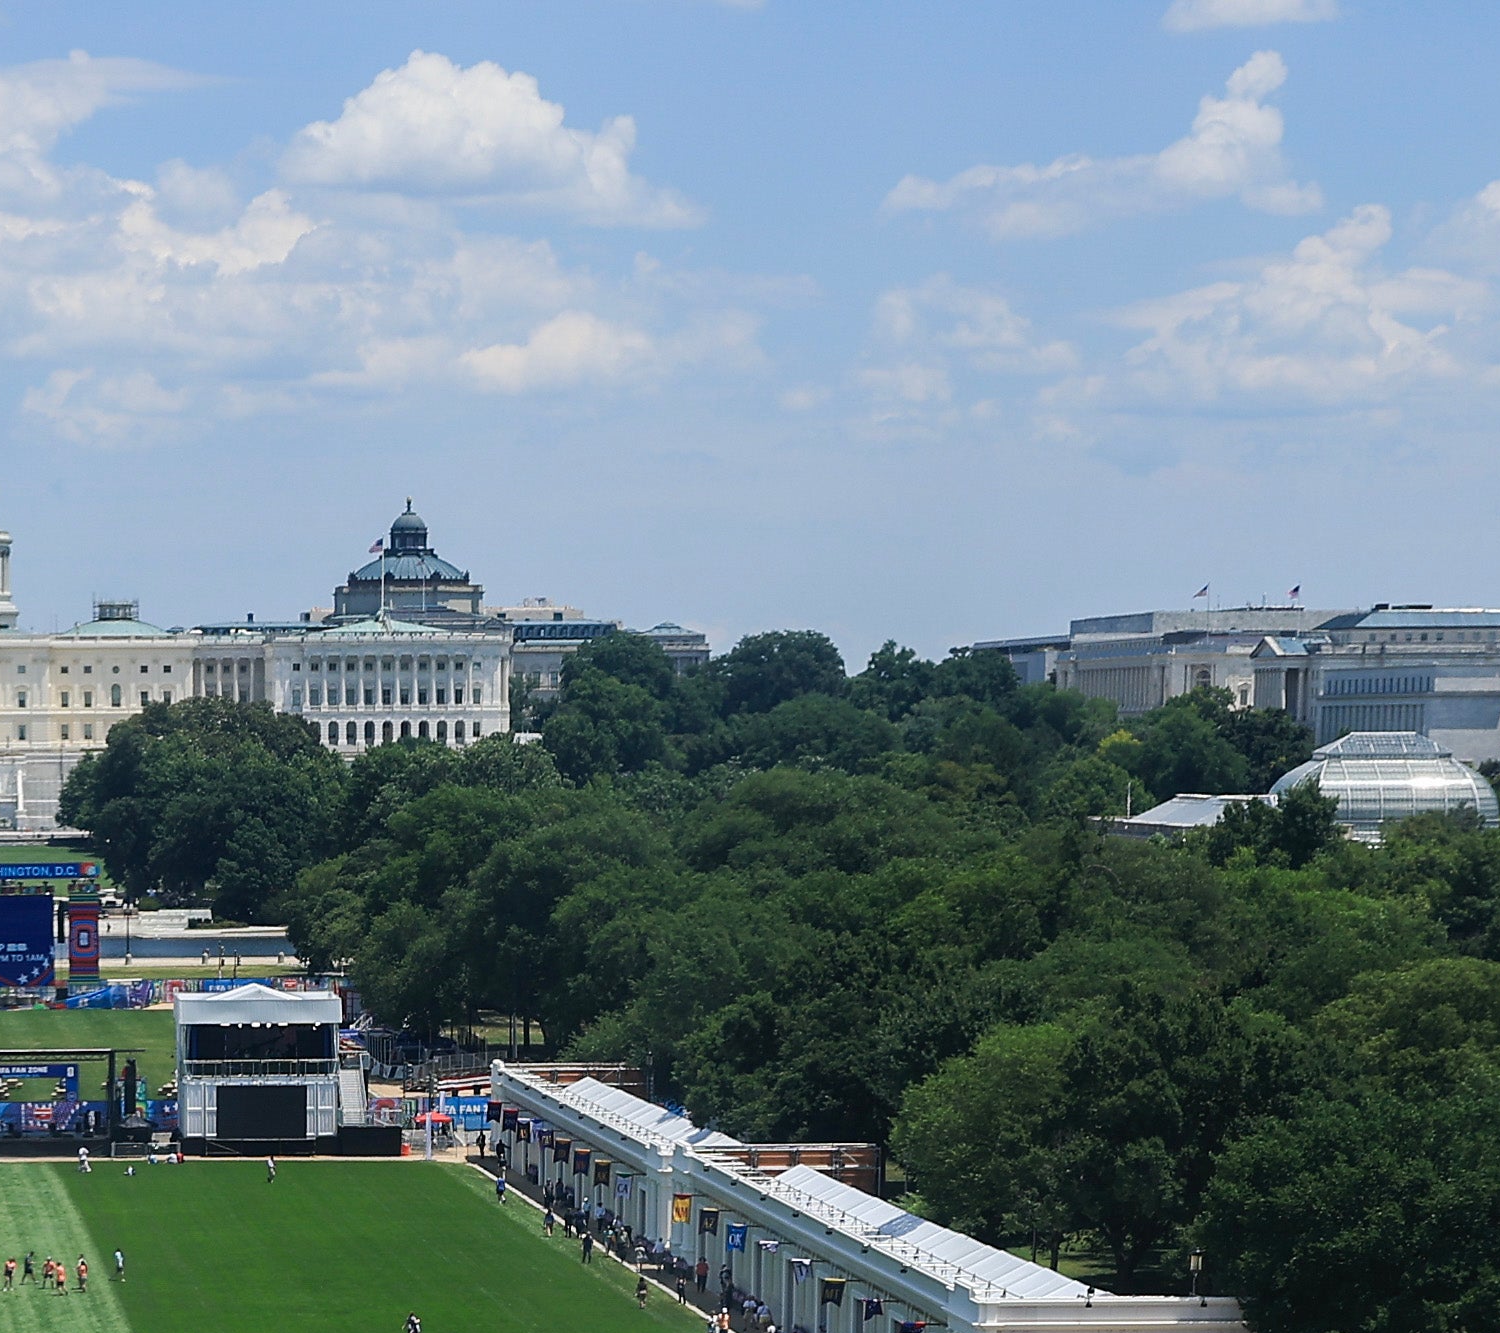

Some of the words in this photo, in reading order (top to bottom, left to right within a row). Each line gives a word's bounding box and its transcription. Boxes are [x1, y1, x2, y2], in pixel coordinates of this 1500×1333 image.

[55, 865, 78, 876] D.C.
[11, 953, 24, 962] TO
[27, 1066, 48, 1074] ZONE
[460, 1104, 481, 1113] FAN
[616, 1183, 629, 1194] CA
[728, 1234, 742, 1247] OK
